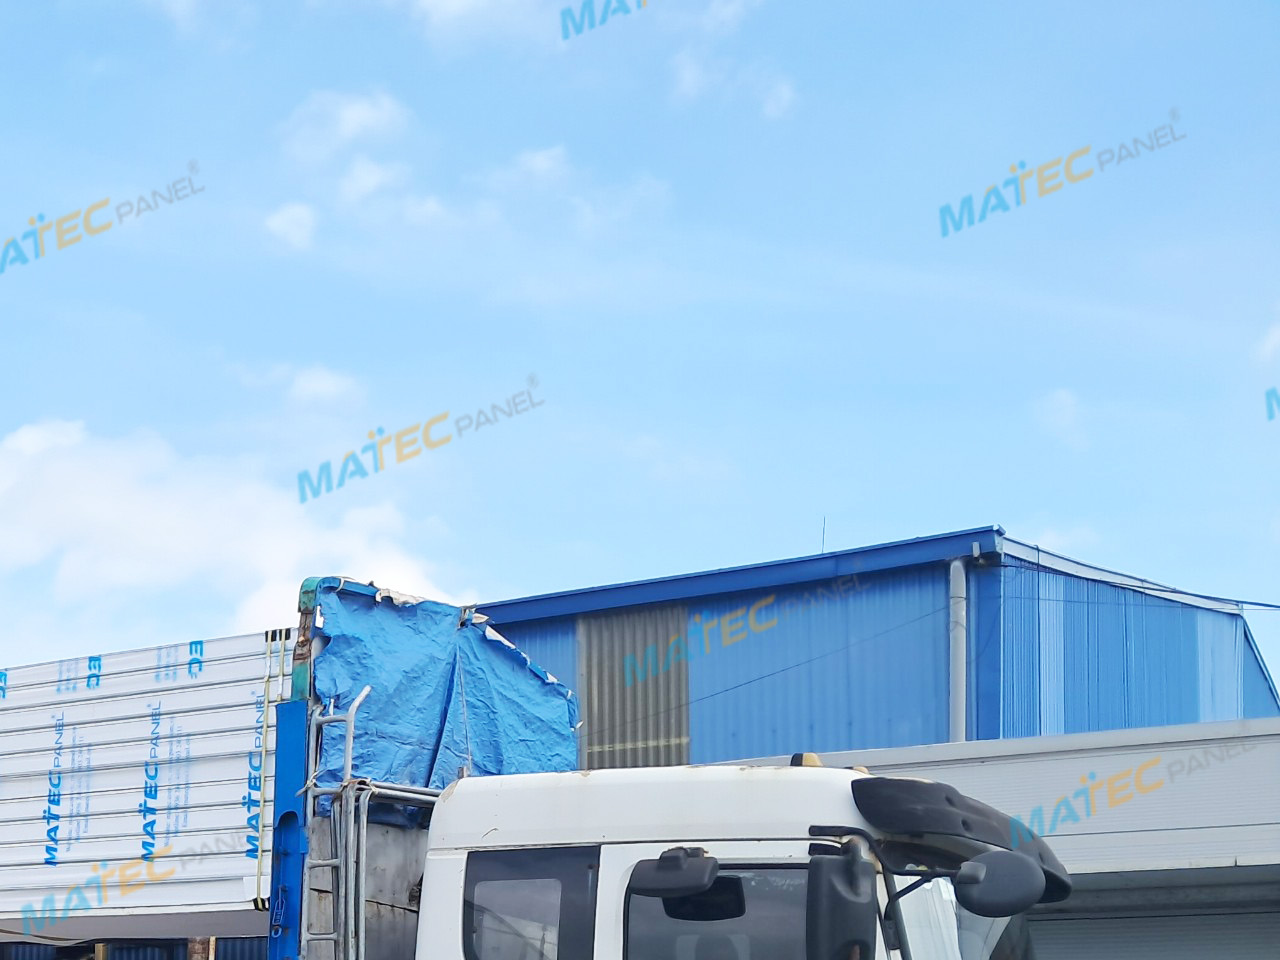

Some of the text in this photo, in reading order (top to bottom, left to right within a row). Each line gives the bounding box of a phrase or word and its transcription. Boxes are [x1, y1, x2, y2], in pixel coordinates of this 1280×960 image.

[43, 711, 65, 866] MATEC PANEL
[138, 700, 162, 862] MATEC PANEL
[242, 693, 266, 859] MATEC PANEL
